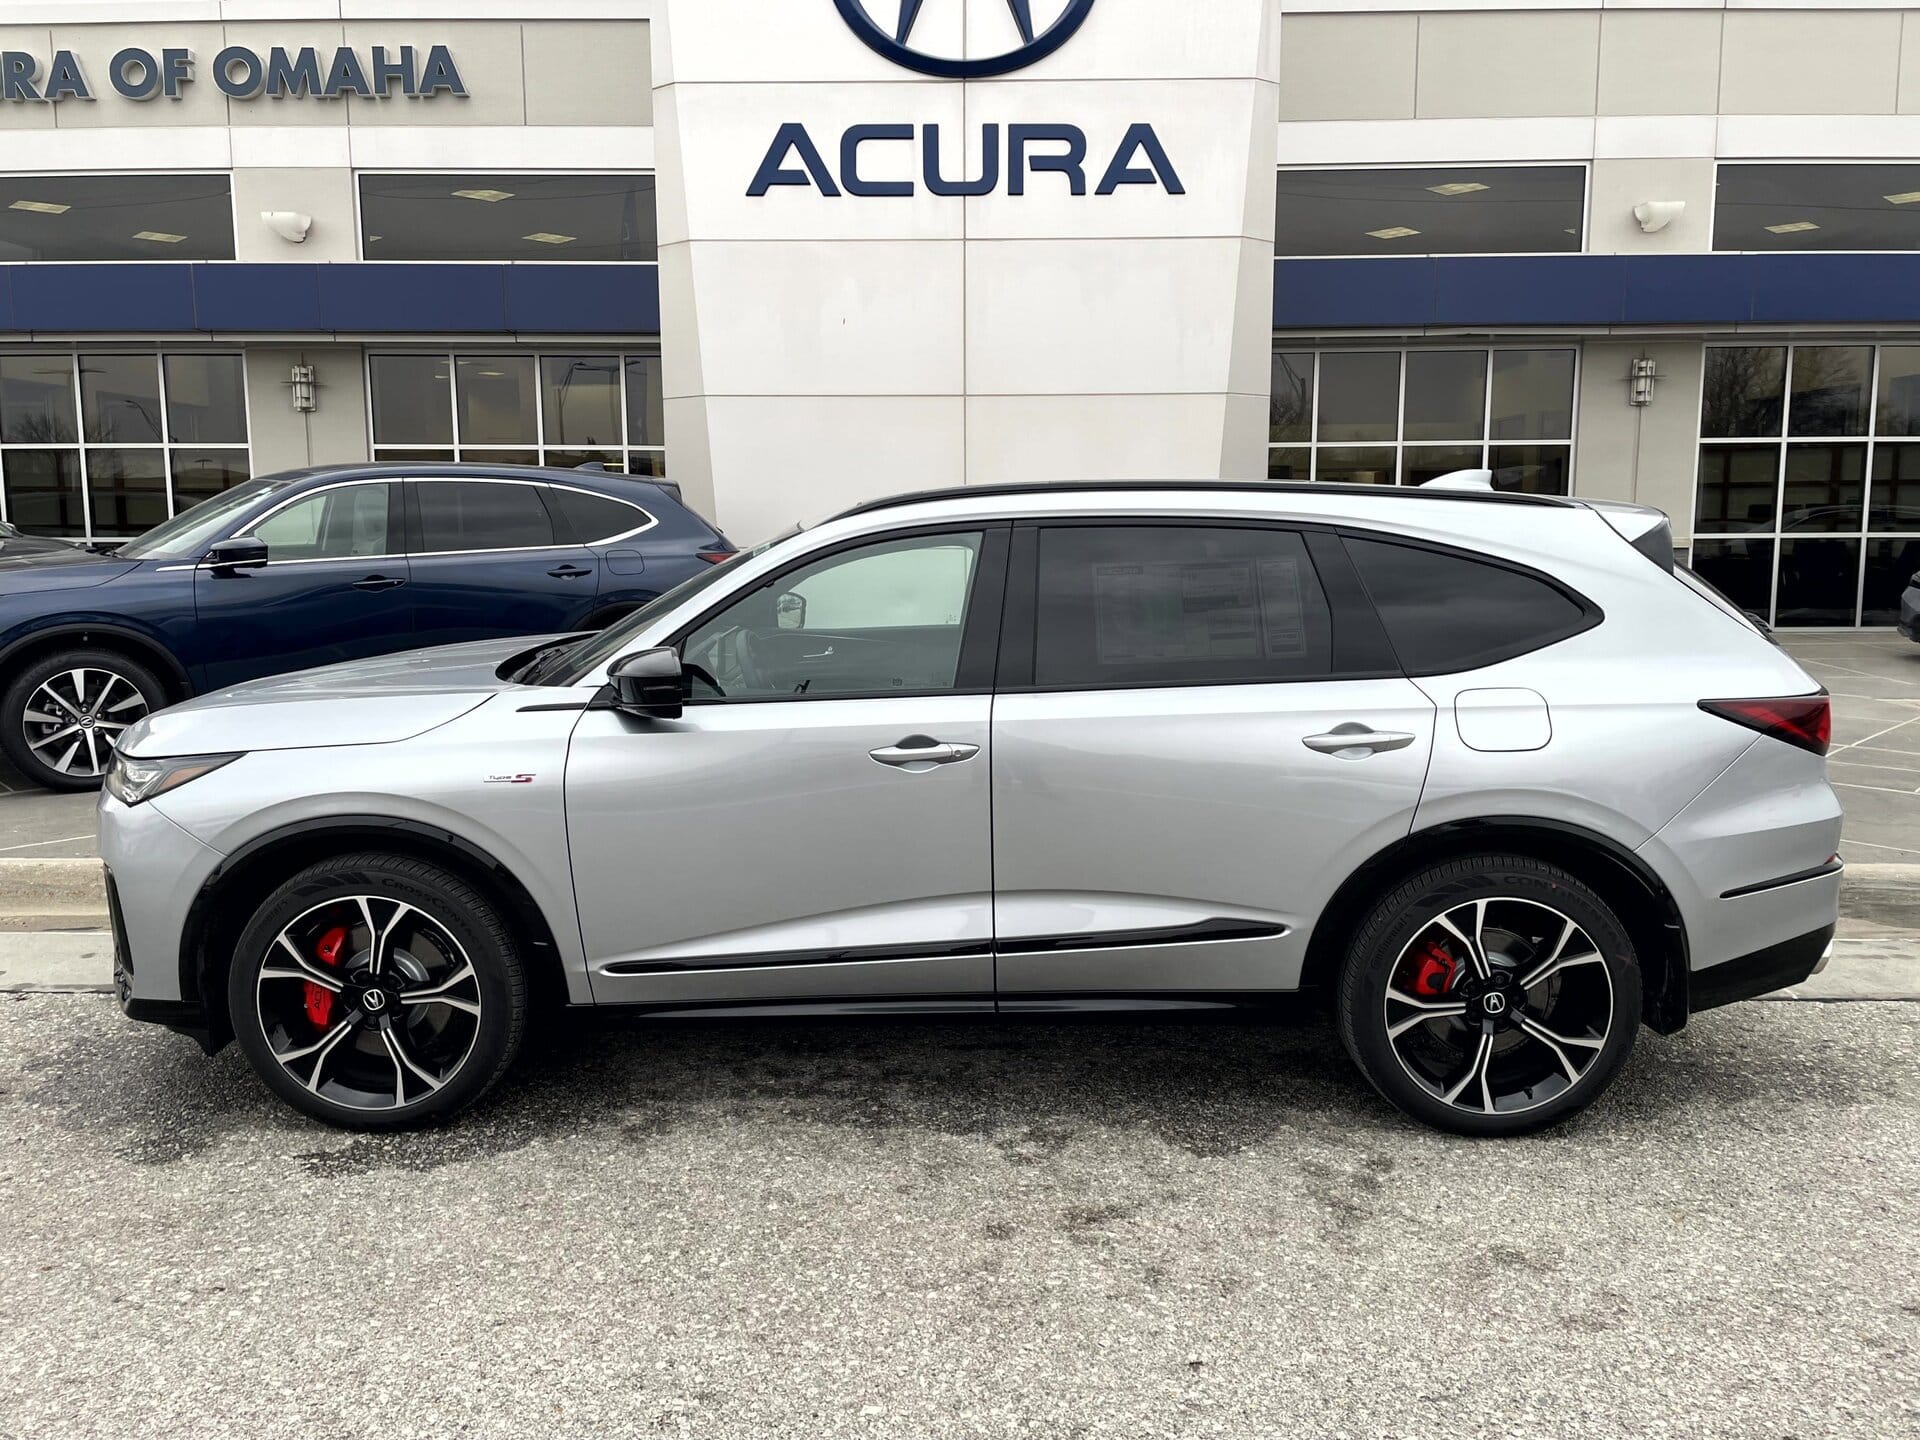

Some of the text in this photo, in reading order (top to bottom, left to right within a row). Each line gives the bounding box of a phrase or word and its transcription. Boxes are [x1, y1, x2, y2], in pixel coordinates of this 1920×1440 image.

[108, 47, 195, 99] OF
[212, 45, 470, 98] OMAHA
[745, 122, 1186, 197] ACURA
